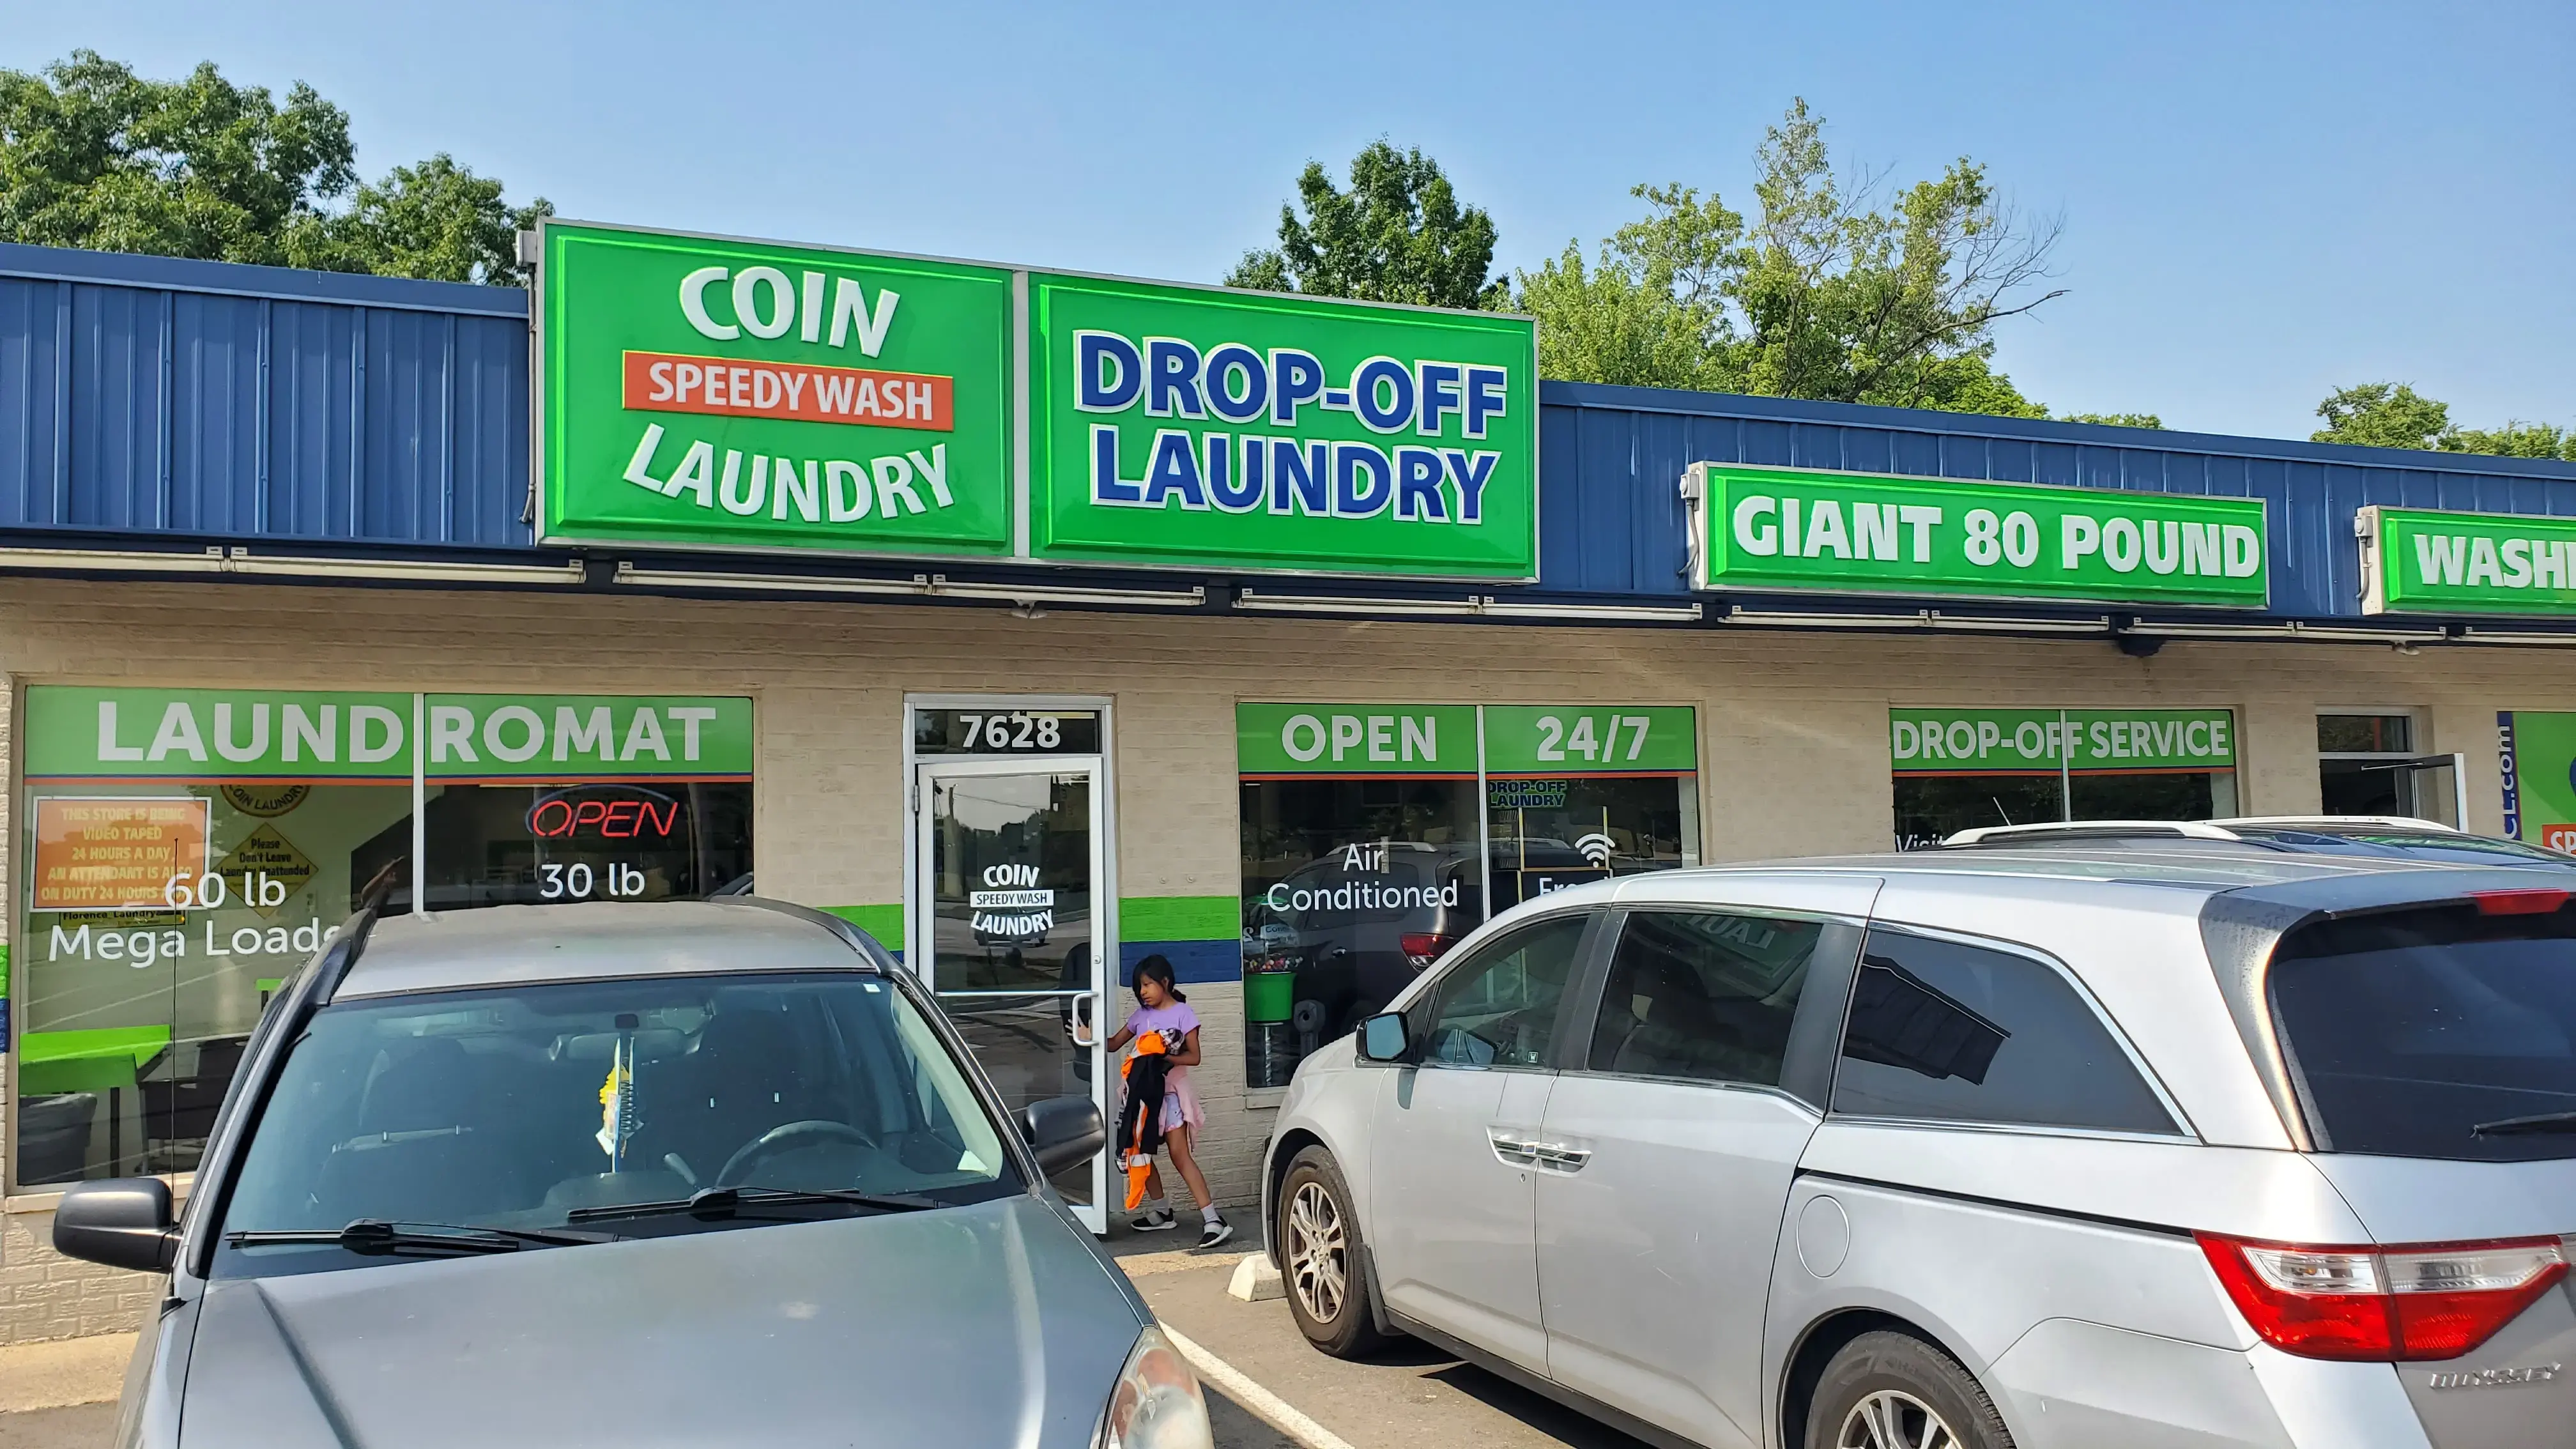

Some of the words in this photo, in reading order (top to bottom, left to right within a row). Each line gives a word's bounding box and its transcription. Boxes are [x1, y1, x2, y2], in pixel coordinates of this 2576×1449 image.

[680, 266, 900, 358] COIN
[648, 362, 808, 411] SPEEDY
[815, 374, 933, 421] WASH
[1072, 329, 1508, 440] DROP-OFF
[623, 422, 954, 523] LAUNDRY
[1089, 423, 1501, 525] LAUNDRY
[1733, 496, 1942, 562] GIANT
[1963, 509, 2039, 568] 80
[2060, 514, 2260, 578] POUND
[960, 716, 1061, 748] 7628
[1281, 714, 1437, 762] OPEN
[1536, 714, 1650, 763] 24/7
[1893, 720, 2083, 759] DROP-OFF
[2090, 720, 2229, 758] SERVICE
[229, 785, 253, 807] OIN
[1489, 781, 1566, 793] DROP-OFF
[1489, 794, 1565, 807] LAUNDRY
[61, 808, 89, 821] THIS
[96, 808, 131, 820] STORE
[135, 808, 146, 820] IS
[150, 808, 185, 820] BEING
[532, 801, 678, 838] OPEN
[83, 827, 119, 840] VIDEO
[123, 827, 162, 840] TAPED
[251, 838, 280, 849] Please
[72, 847, 87, 861] 24
[90, 847, 131, 860] HOURS
[134, 847, 143, 860] A
[240, 852, 263, 862] Don't
[266, 852, 291, 862] Leave
[1344, 843, 1383, 871] Air
[48, 867, 66, 880] AN
[69, 866, 144, 880] ATTENDANT
[148, 867, 158, 879] IS
[540, 863, 593, 898] 30
[608, 862, 645, 895] lb
[984, 864, 1040, 887] COIN
[42, 887, 60, 901] ON
[63, 887, 96, 900] DUTY
[100, 887, 114, 900] 24
[118, 887, 158, 900] HOURS
[164, 872, 226, 908] 60
[245, 871, 286, 907] lb
[976, 894, 1015, 905] SPEEDY
[1016, 893, 1048, 903] WASH
[1267, 880, 1458, 912] Conditioned
[64, 911, 108, 920] Florence
[970, 908, 1054, 935] LAUNDRY
[49, 924, 185, 968] Mega
